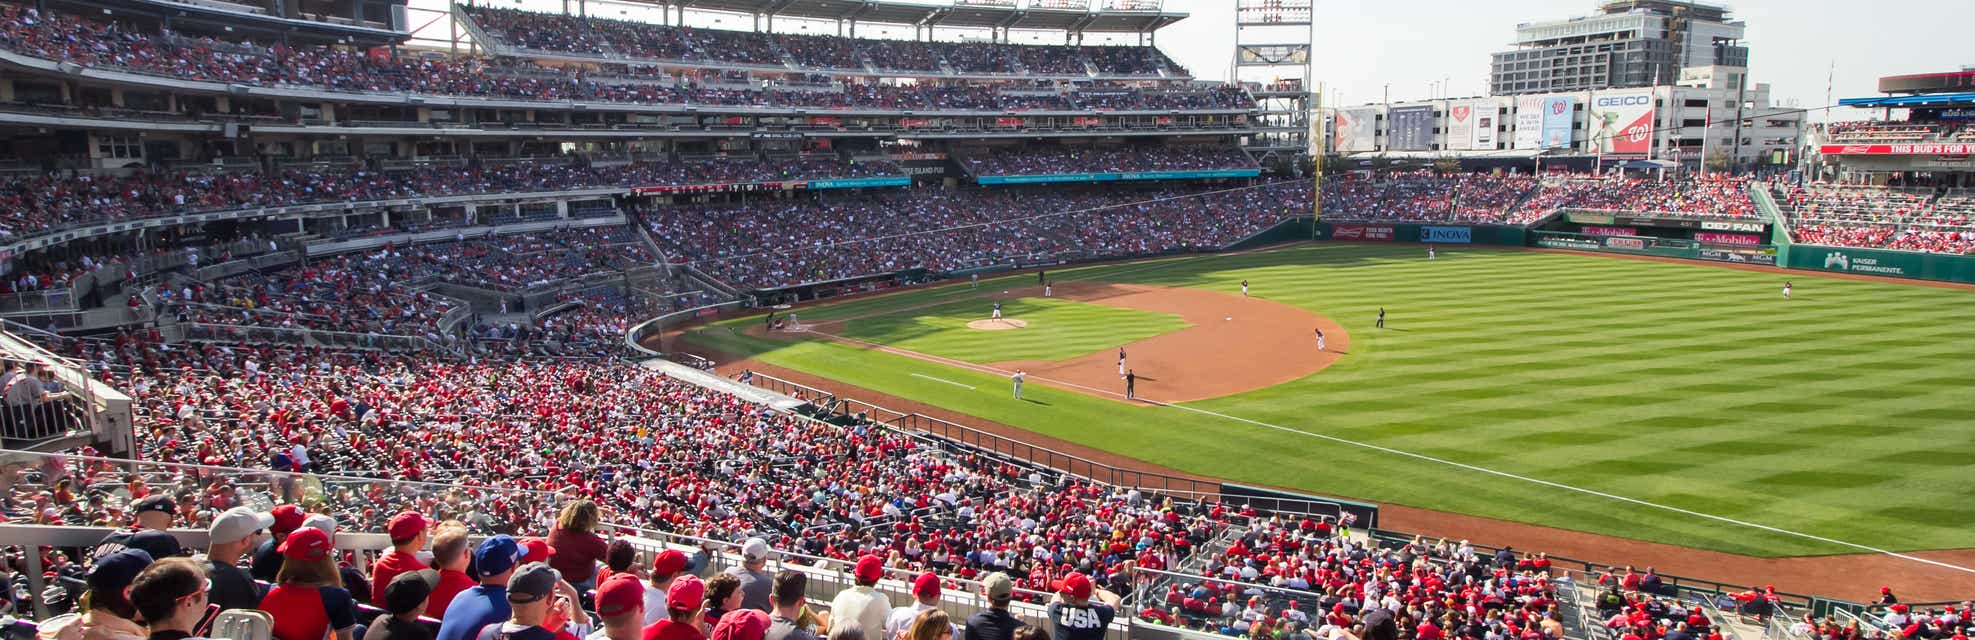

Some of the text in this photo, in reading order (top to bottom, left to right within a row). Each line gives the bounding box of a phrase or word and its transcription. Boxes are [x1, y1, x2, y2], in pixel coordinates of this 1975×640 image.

[1598, 96, 1649, 106] GEICO
[1891, 145, 1911, 153] THIS
[1913, 145, 1941, 153] BUD'S
[1944, 145, 1963, 153] FOR
[1733, 224, 1764, 232] FAN
[1433, 230, 1470, 239] INOVA
[1033, 578, 1044, 588] 34
[1061, 607, 1101, 629] USA
